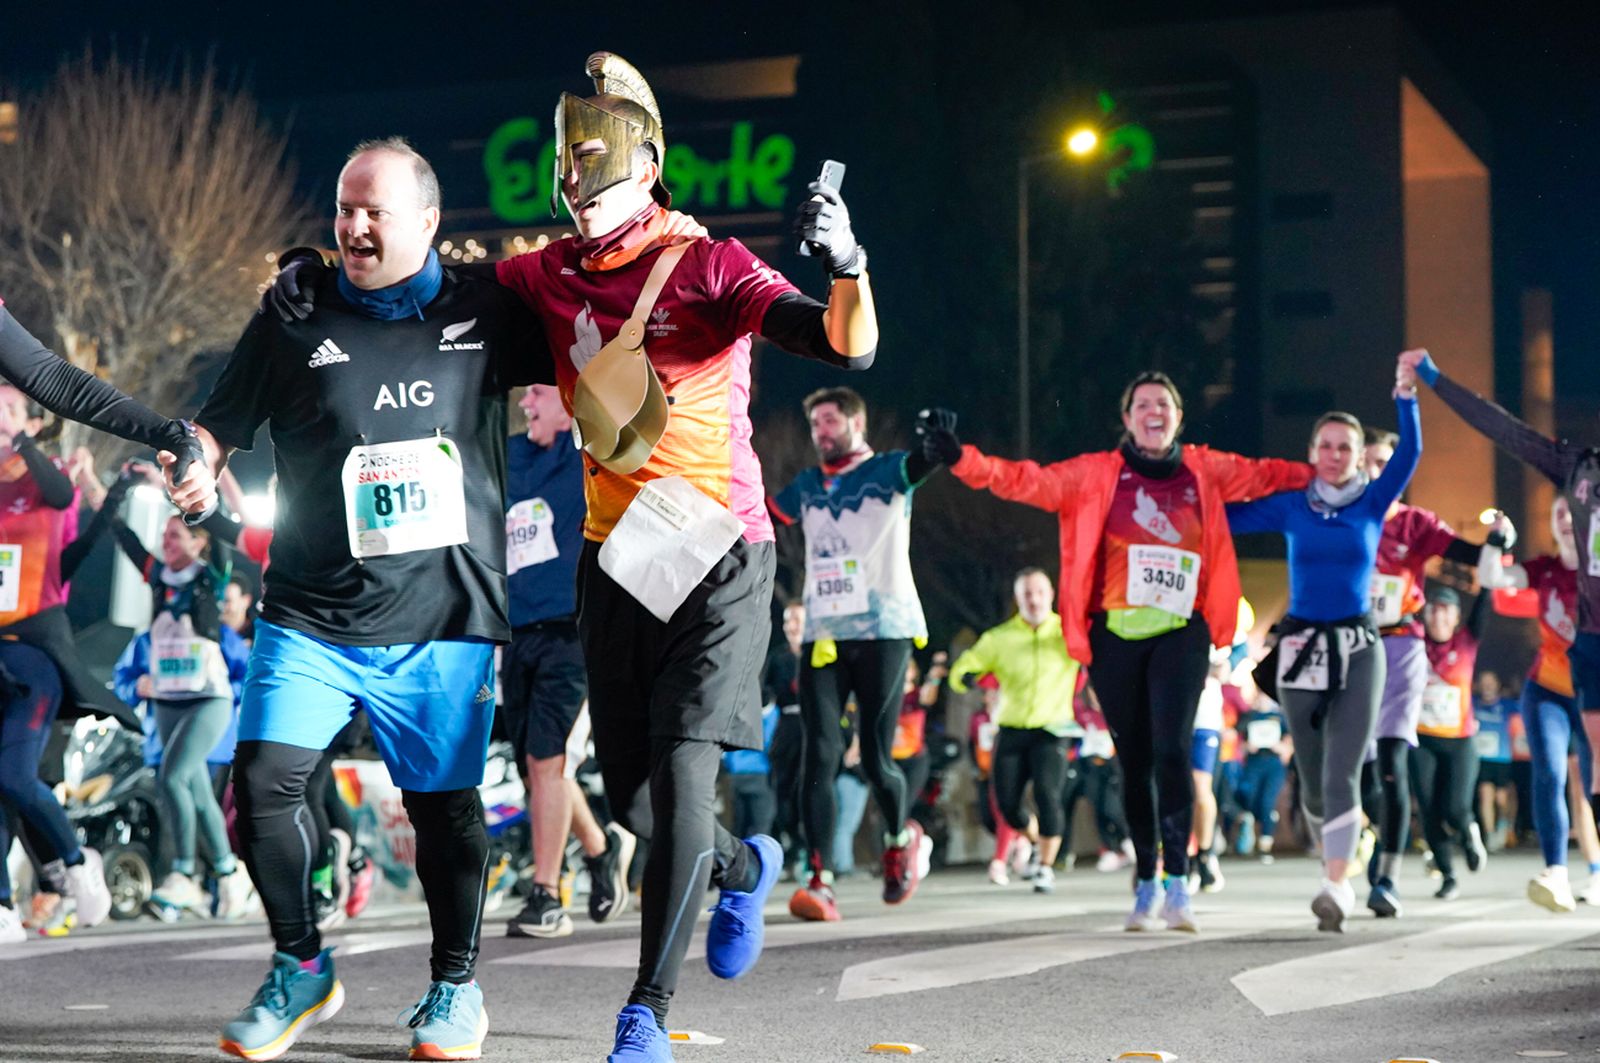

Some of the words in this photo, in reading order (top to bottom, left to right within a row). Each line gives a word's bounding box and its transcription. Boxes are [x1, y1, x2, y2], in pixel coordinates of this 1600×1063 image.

[308, 353, 350, 369] adidas
[373, 380, 435, 411] AIG
[358, 470, 380, 484] SAN
[373, 481, 427, 517] 815
[1143, 567, 1186, 592] 3430
